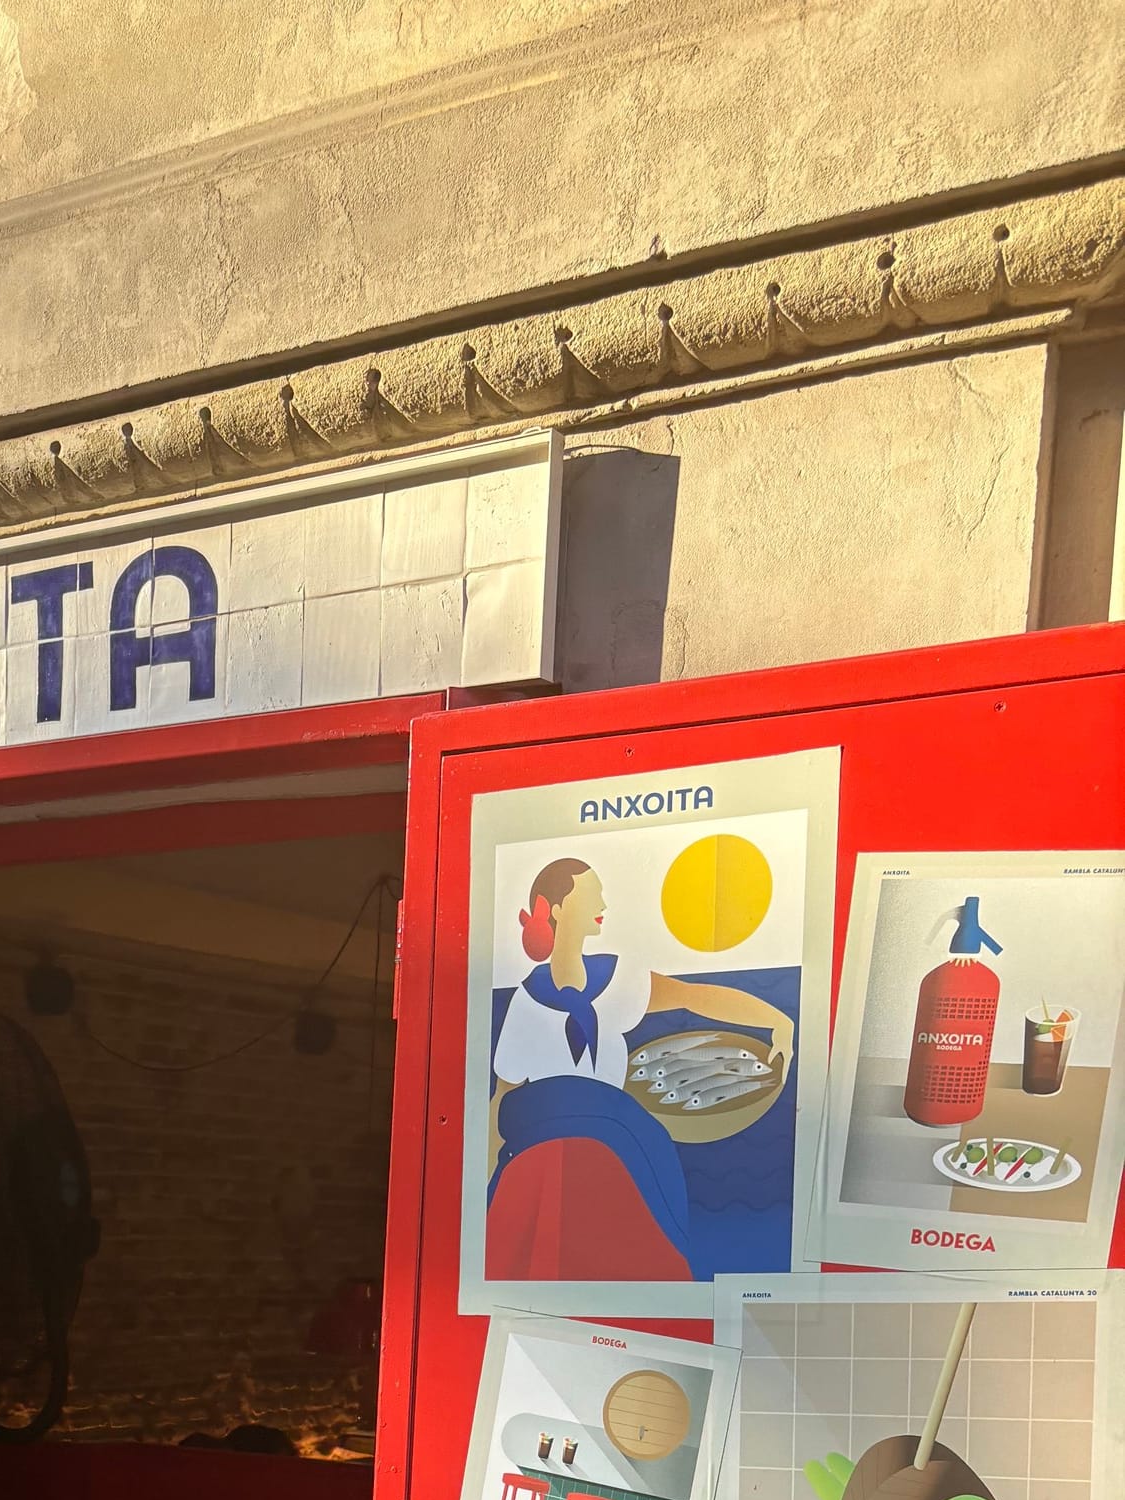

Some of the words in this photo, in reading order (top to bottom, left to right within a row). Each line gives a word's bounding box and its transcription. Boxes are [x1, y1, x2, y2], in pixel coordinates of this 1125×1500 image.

[579, 785, 714, 824] ANXOITA
[917, 1032, 983, 1046] ANXOITA
[909, 1228, 996, 1254] BODEGA
[592, 1336, 627, 1349] BODEGA
